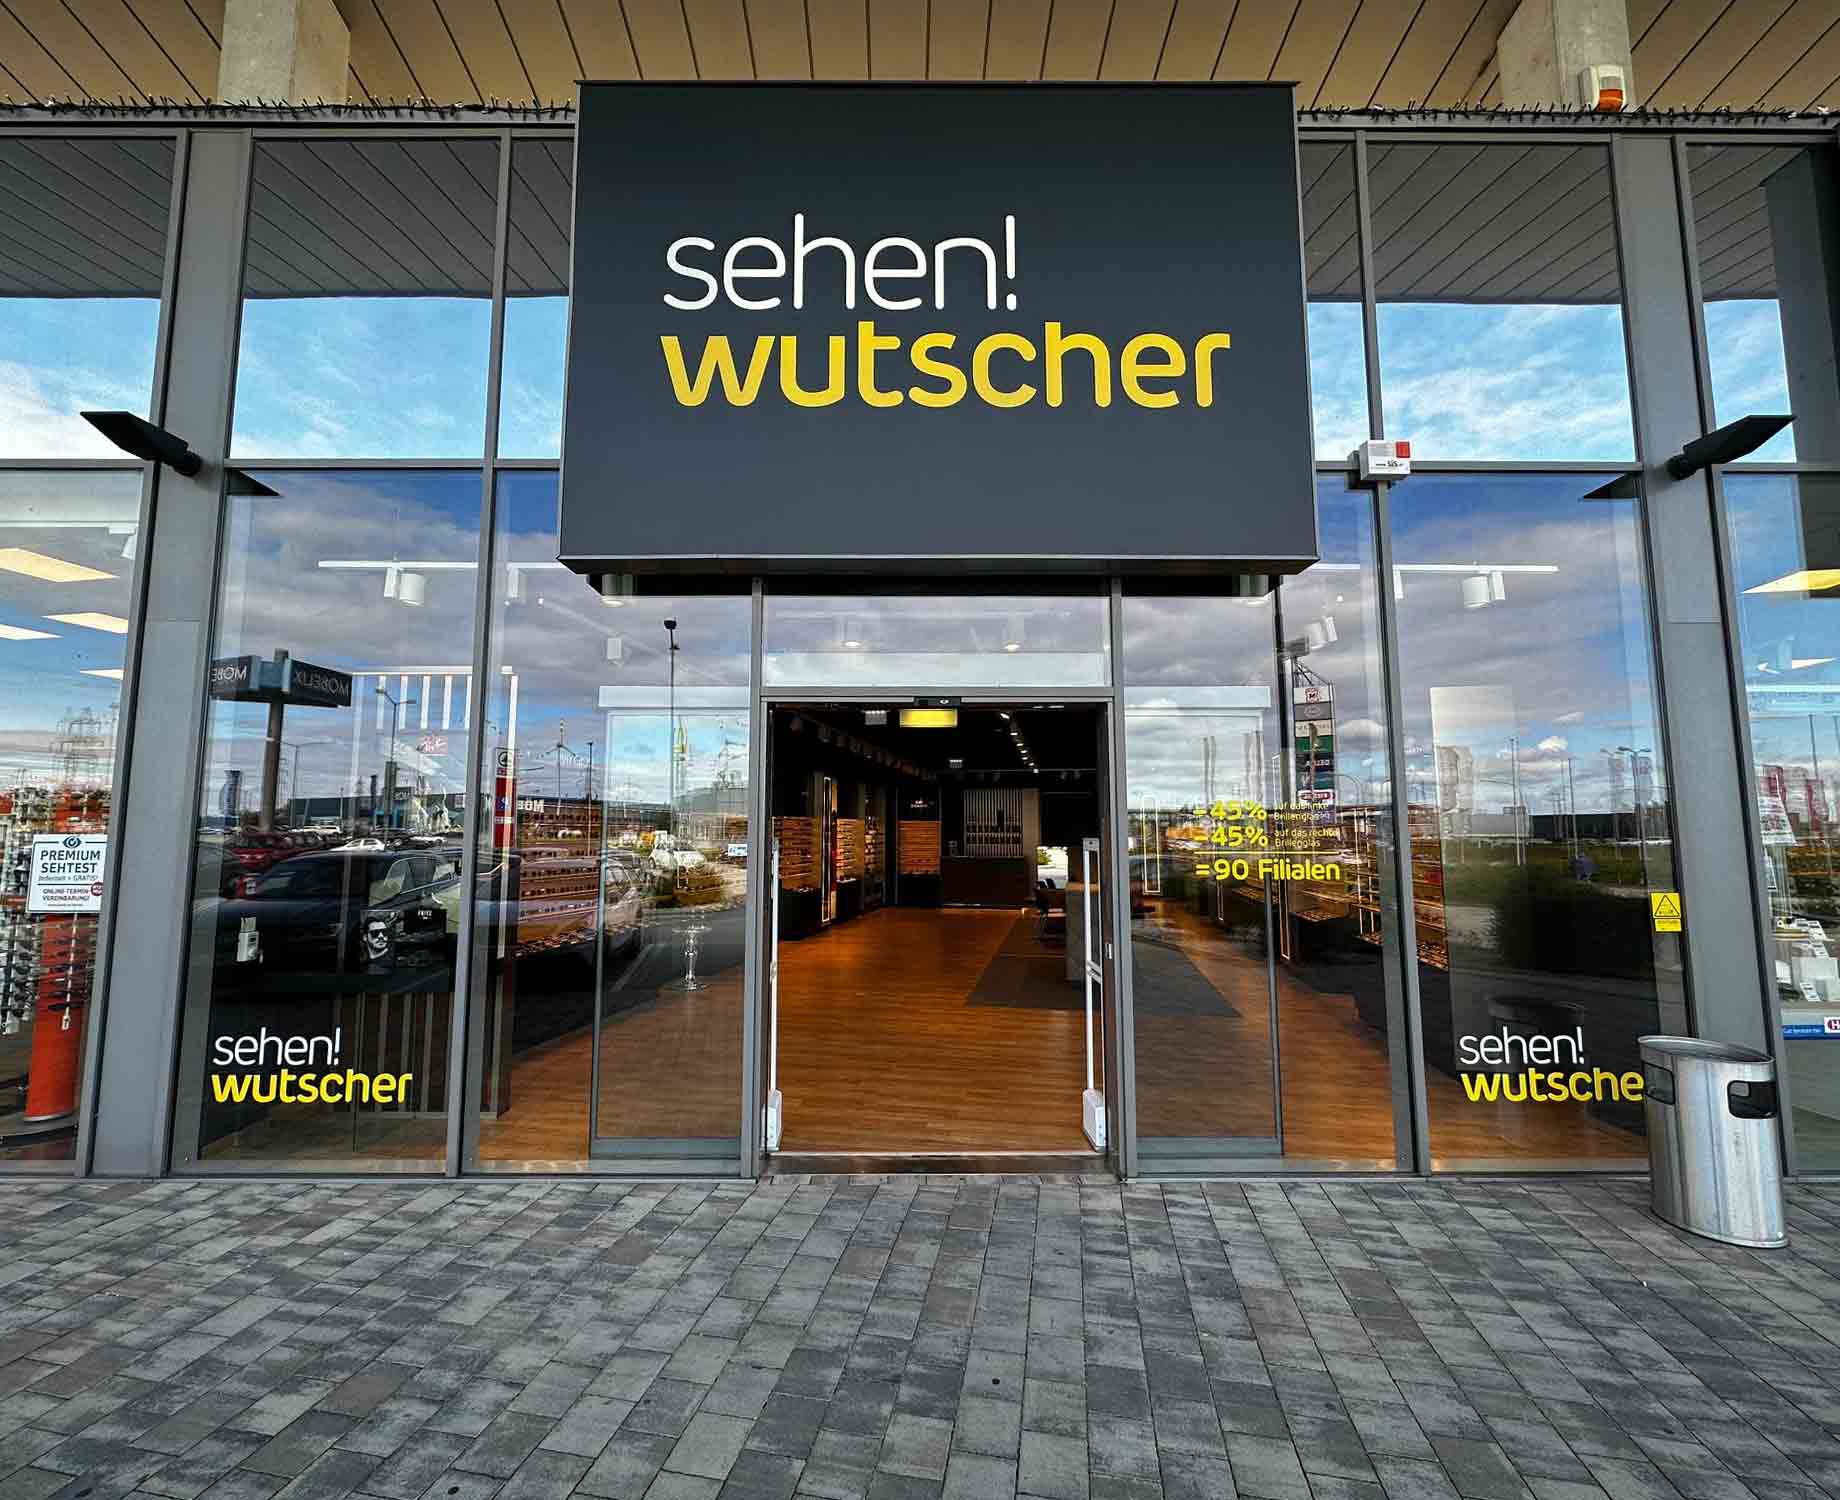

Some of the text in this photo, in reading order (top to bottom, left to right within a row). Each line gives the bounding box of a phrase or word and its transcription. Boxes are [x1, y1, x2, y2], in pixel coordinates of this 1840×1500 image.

[664, 213, 1017, 311] sehen!
[661, 321, 1231, 409] wutscher
[40, 850, 101, 861] PREMIUM
[41, 862, 97, 873] SEHTEST
[1195, 857, 1341, 881] =90 Filialen
[213, 1027, 341, 1066] sehen!
[1459, 1026, 1585, 1064] sehen!
[211, 1069, 413, 1104] wutscher
[1461, 1068, 1645, 1102] wutsche
